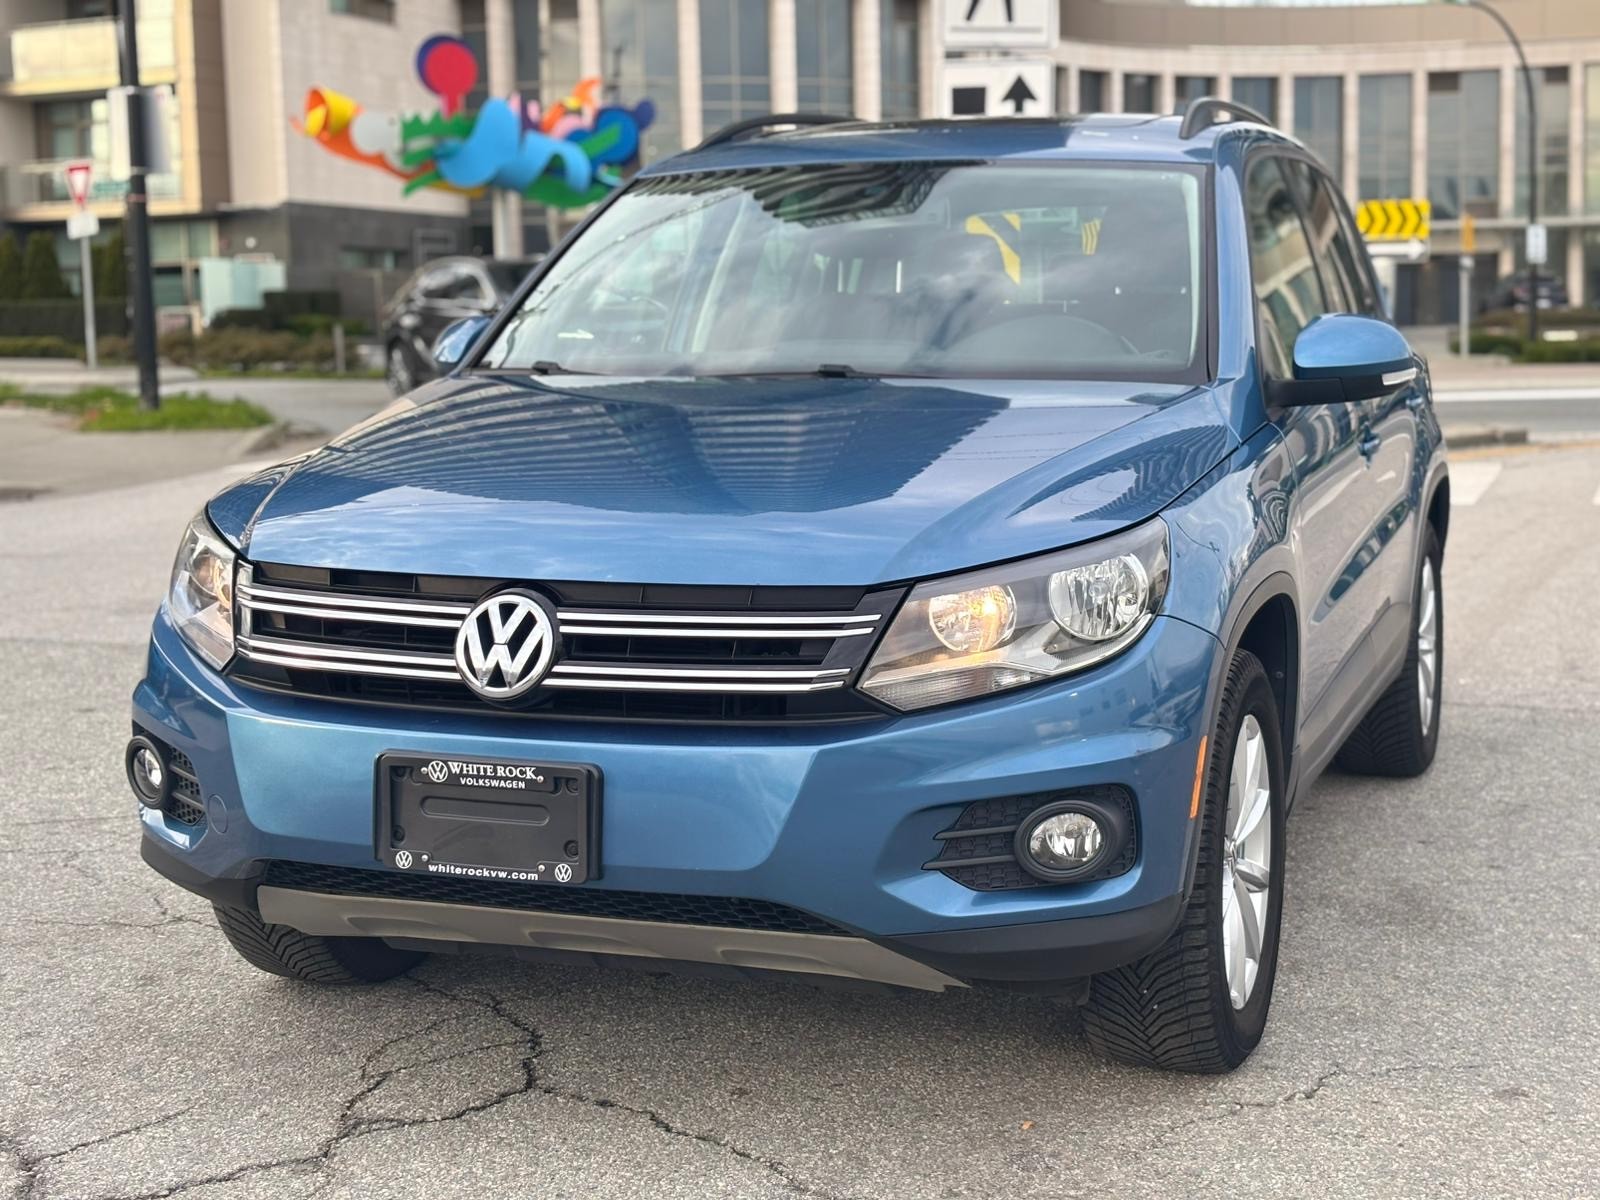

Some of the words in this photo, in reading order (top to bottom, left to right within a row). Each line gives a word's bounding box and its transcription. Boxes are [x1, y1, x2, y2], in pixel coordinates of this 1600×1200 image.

[448, 761, 495, 776] WHITE
[497, 766, 537, 780] ROCK
[460, 777, 526, 789] VOLKSWAGEN
[428, 864, 538, 881] whiterockvw.com
